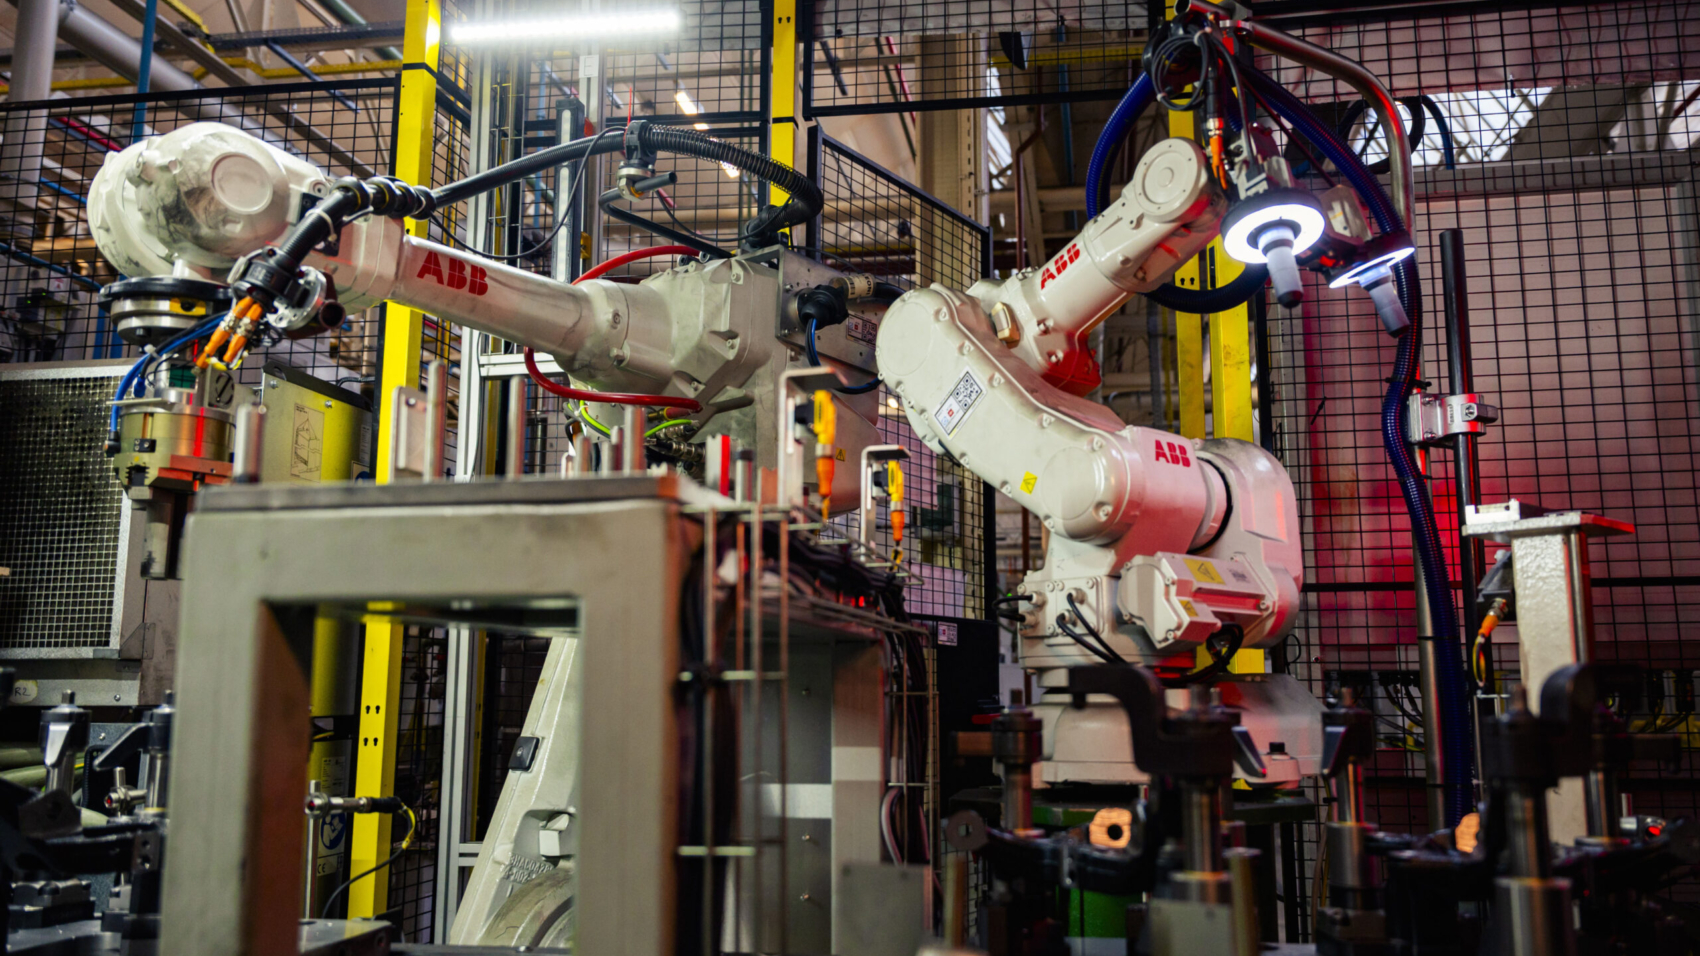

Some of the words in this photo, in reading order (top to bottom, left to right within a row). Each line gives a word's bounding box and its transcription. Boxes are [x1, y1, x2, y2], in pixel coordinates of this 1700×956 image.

[416, 250, 489, 296] ABB
[1041, 243, 1080, 291] ABB
[1155, 439, 1191, 468] ABB
[15, 686, 31, 697] R2
